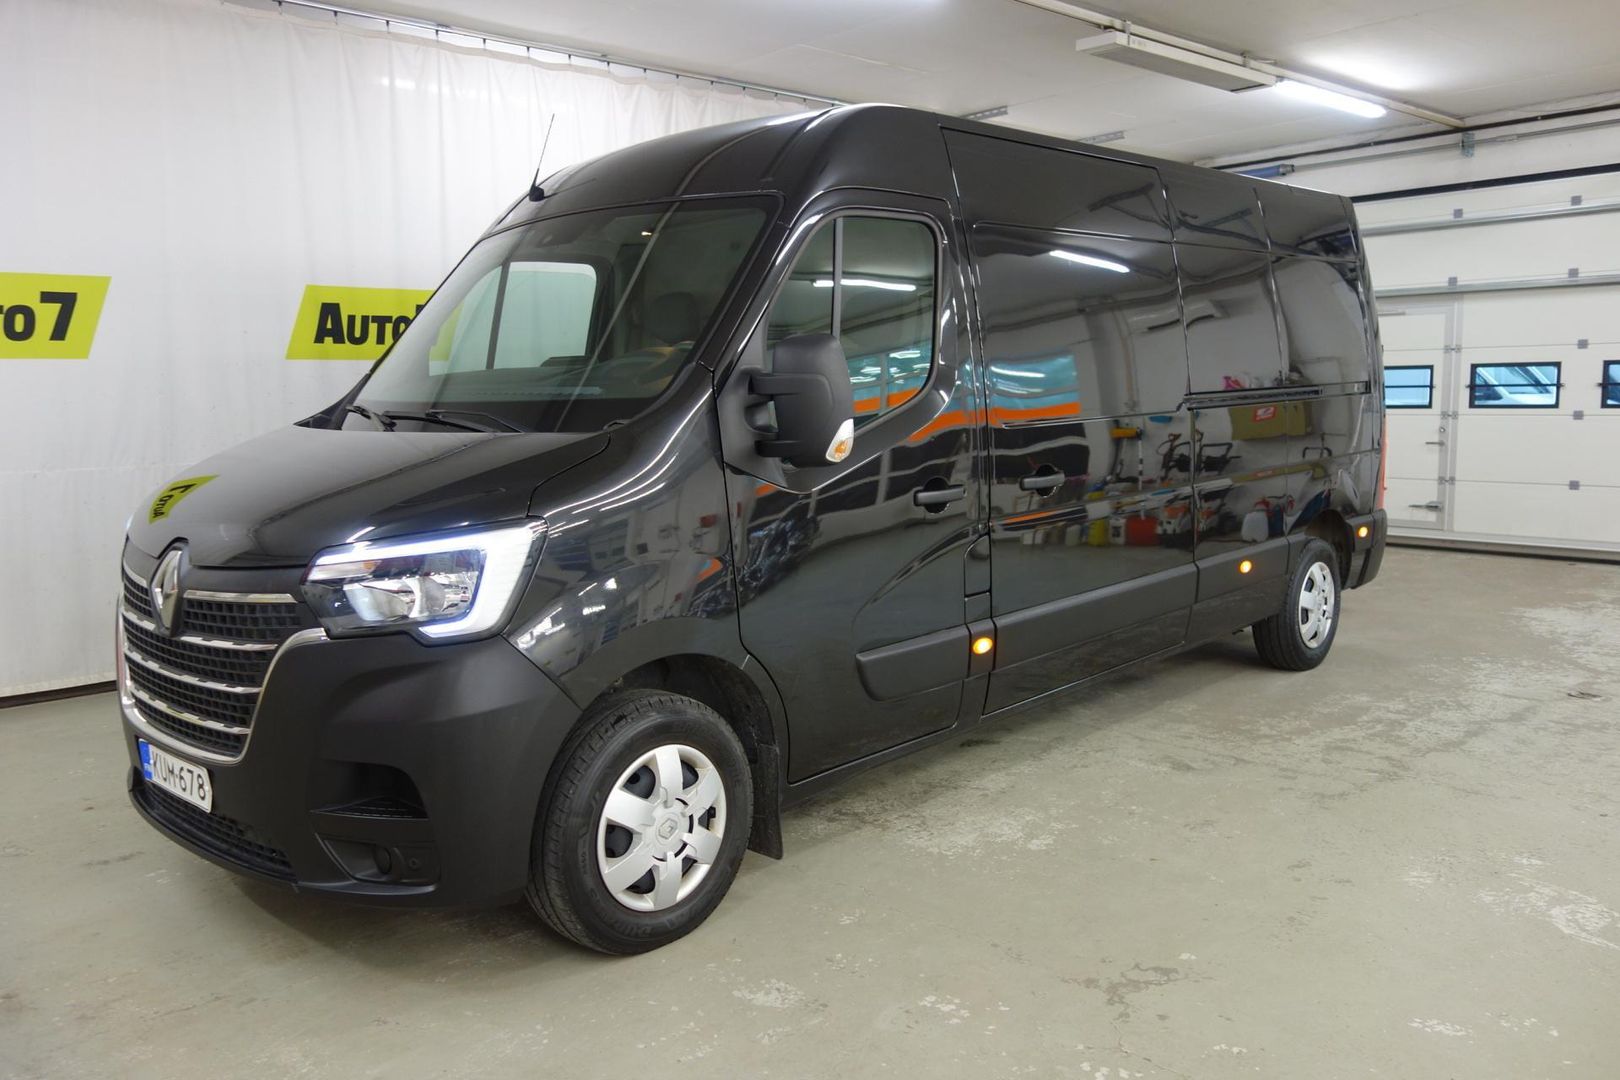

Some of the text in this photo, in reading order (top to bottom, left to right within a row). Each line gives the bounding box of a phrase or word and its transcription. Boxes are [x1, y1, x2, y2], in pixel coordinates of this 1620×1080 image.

[0, 291, 77, 341] O7
[314, 302, 424, 345] AUTO
[152, 750, 206, 801] KUM-678
